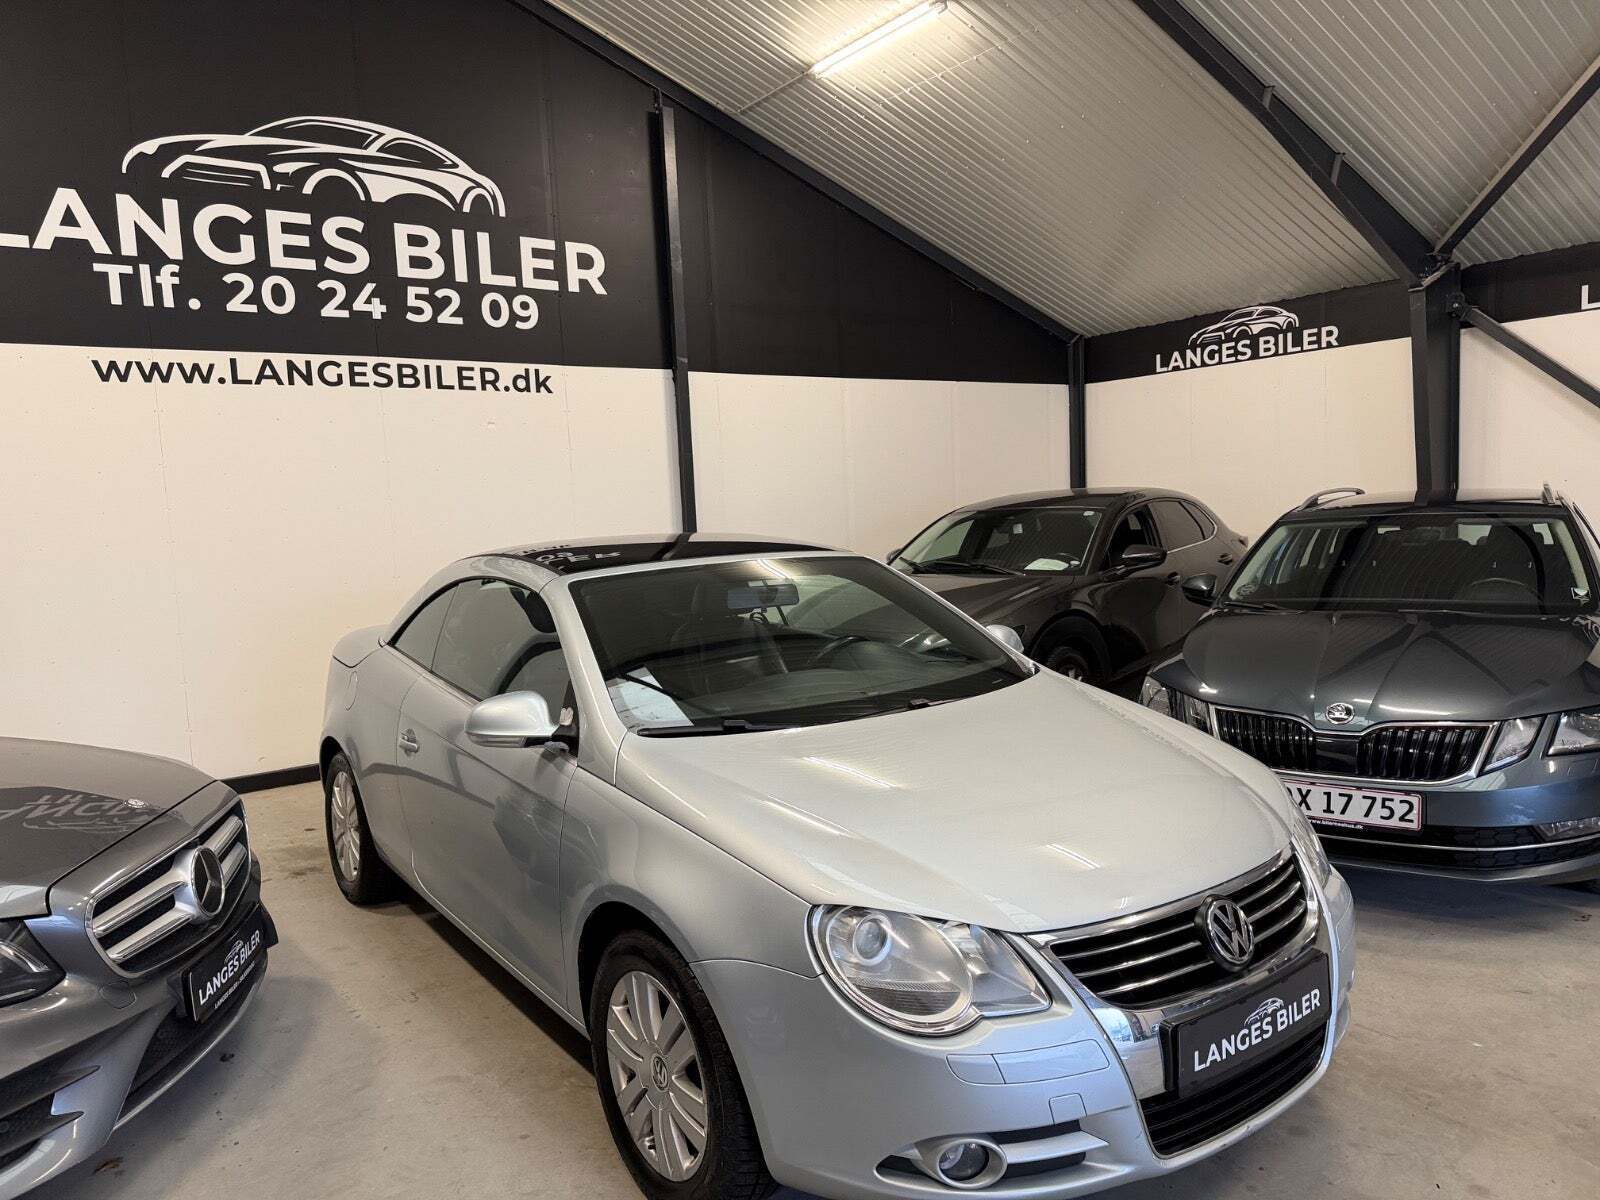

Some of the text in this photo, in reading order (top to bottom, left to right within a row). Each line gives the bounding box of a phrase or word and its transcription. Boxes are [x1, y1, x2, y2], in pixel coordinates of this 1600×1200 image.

[393, 223, 608, 295] BILER
[92, 263, 539, 330] Tlf. 20 24 52 09
[91, 357, 554, 394] www.LANGESBILER.dk
[1155, 325, 1339, 373] LANGES BILER
[1322, 791, 1353, 815] 17
[1361, 795, 1415, 823] 752
[199, 955, 239, 1006] LANGES
[240, 929, 260, 965] BILER
[1194, 988, 1321, 1072] LANGES BILER
